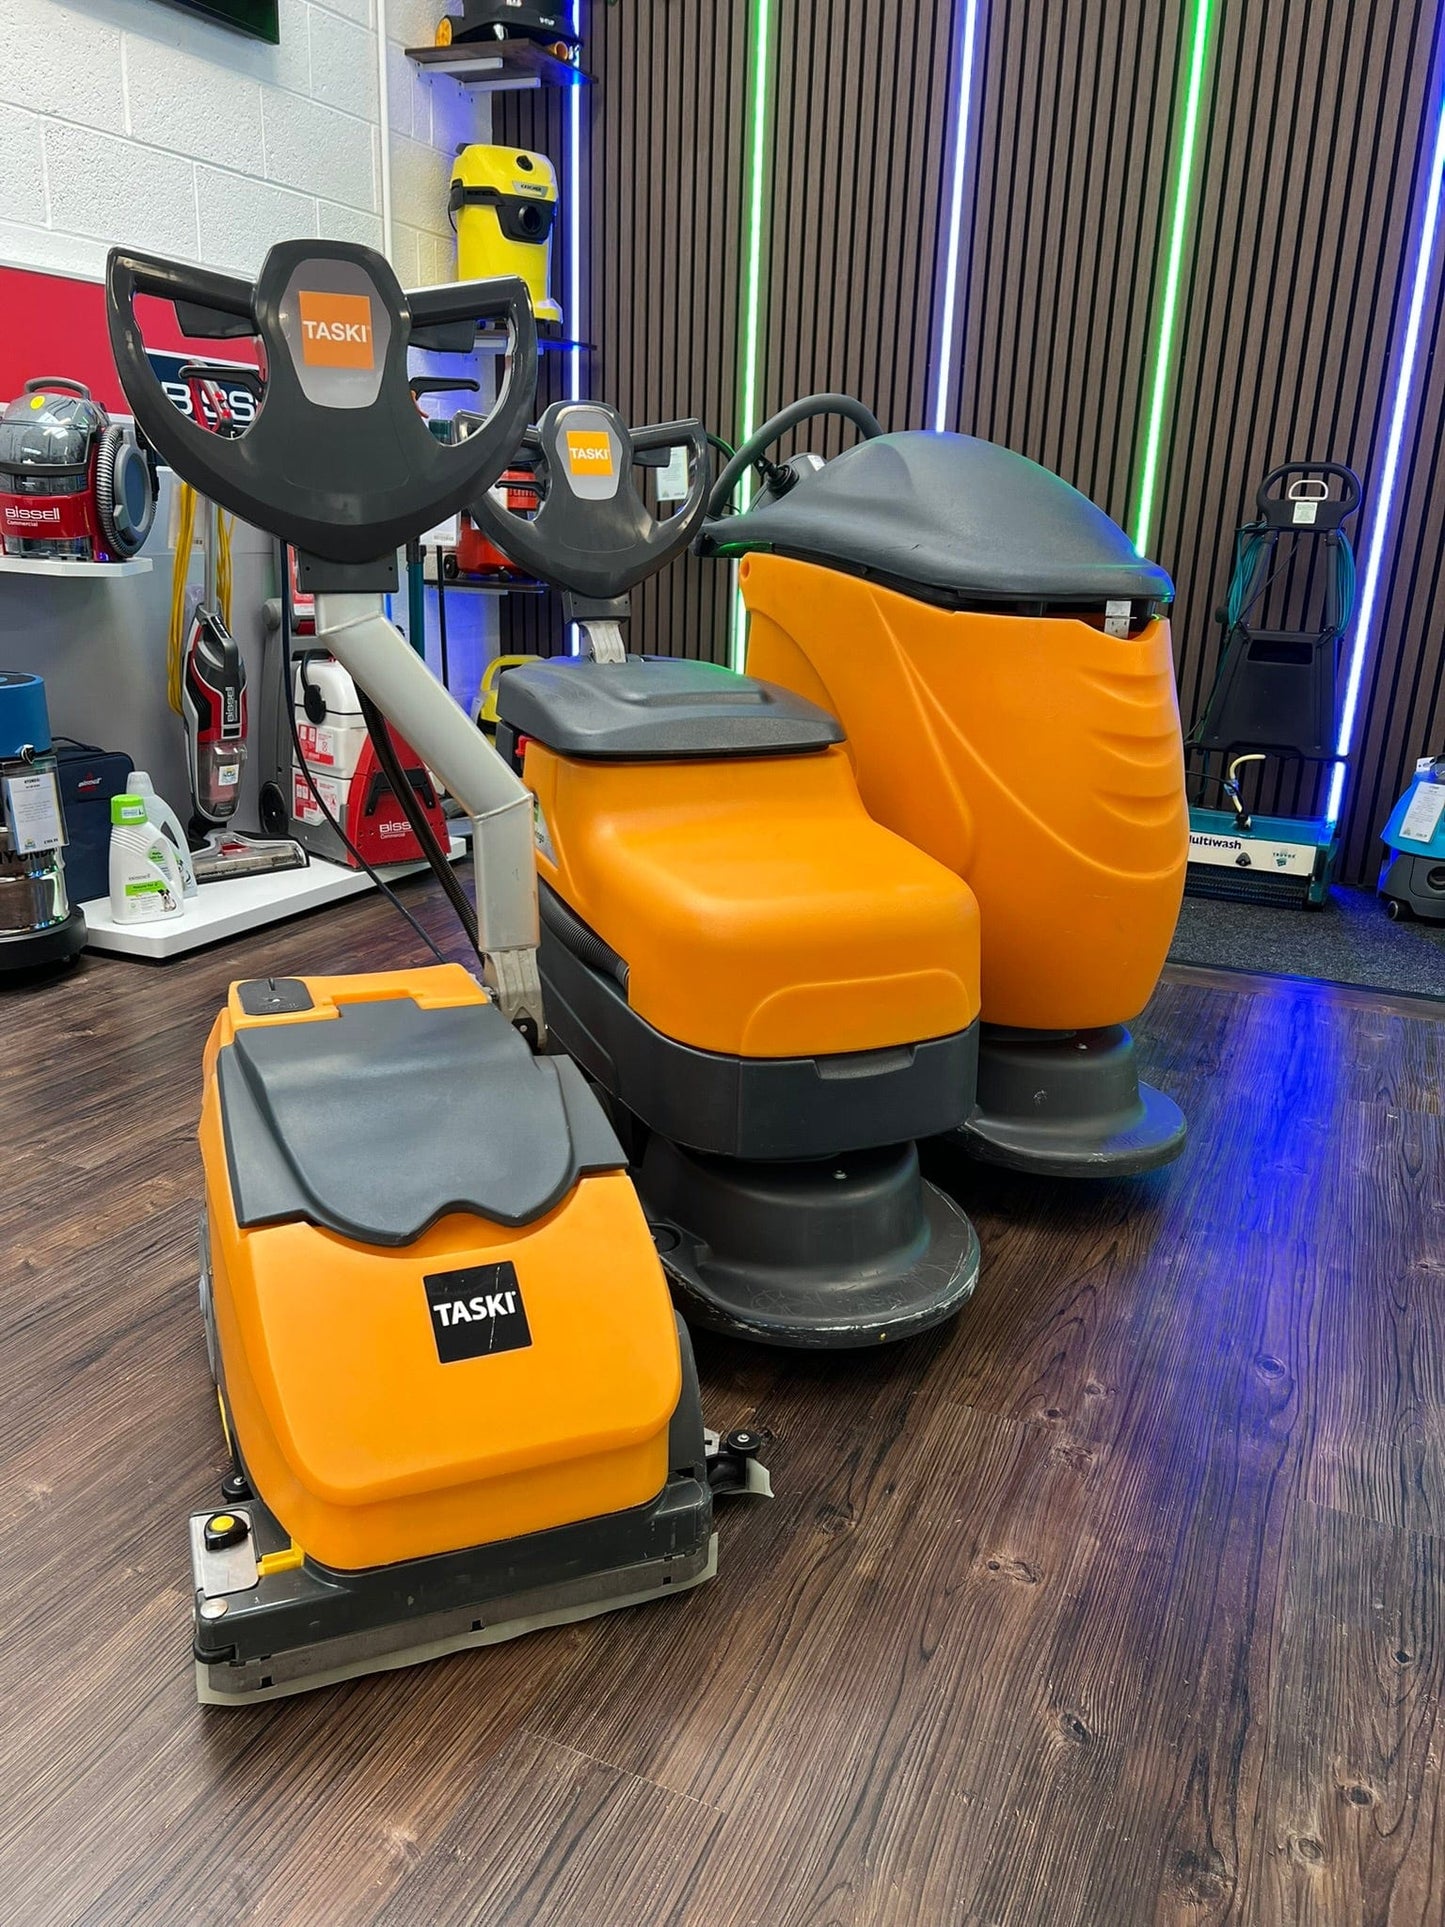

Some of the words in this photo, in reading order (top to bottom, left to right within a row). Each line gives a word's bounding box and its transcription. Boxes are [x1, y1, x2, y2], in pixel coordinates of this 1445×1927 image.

[302, 320, 367, 343] TASKI
[569, 447, 609, 460] TASKI
[432, 1290, 516, 1327] TASKI
